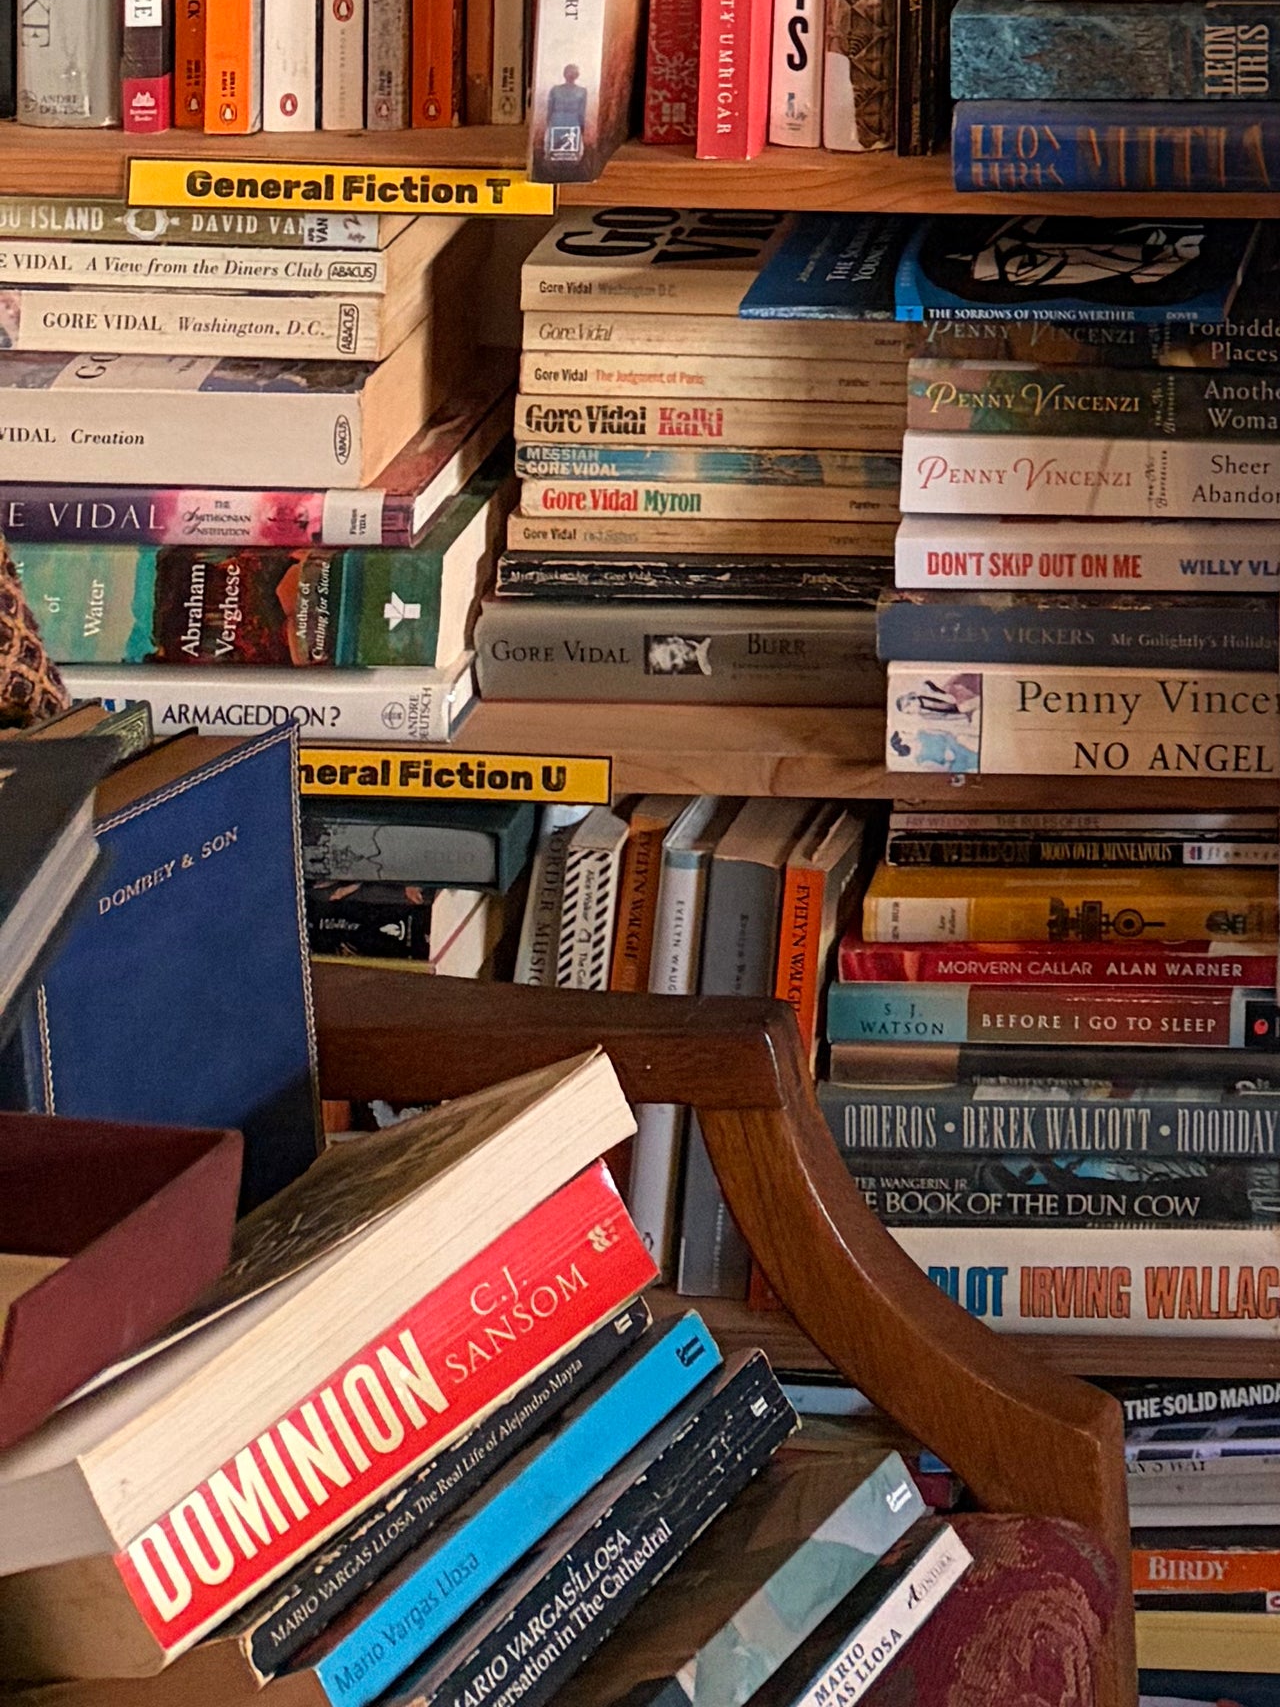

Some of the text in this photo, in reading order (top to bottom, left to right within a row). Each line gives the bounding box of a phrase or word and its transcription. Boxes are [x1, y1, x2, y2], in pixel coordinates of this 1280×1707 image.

[186, 171, 511, 203] General Fiction T
[43, 312, 162, 331] GORE VIDAL
[525, 404, 580, 437] Gore
[584, 405, 647, 435] Vidal
[162, 703, 341, 728] ARMAGEDDON?
[937, 959, 1242, 978] MORVERN CALLAR ALAN WARNER
[860, 1018, 945, 1036] WATSON
[844, 1107, 936, 1150] OMEROS
[1020, 1266, 1135, 1319] IRVING
[445, 1260, 589, 1384] SANSOM
[129, 1328, 450, 1621] DOMINION
[1148, 1556, 1228, 1582] BIRDY
